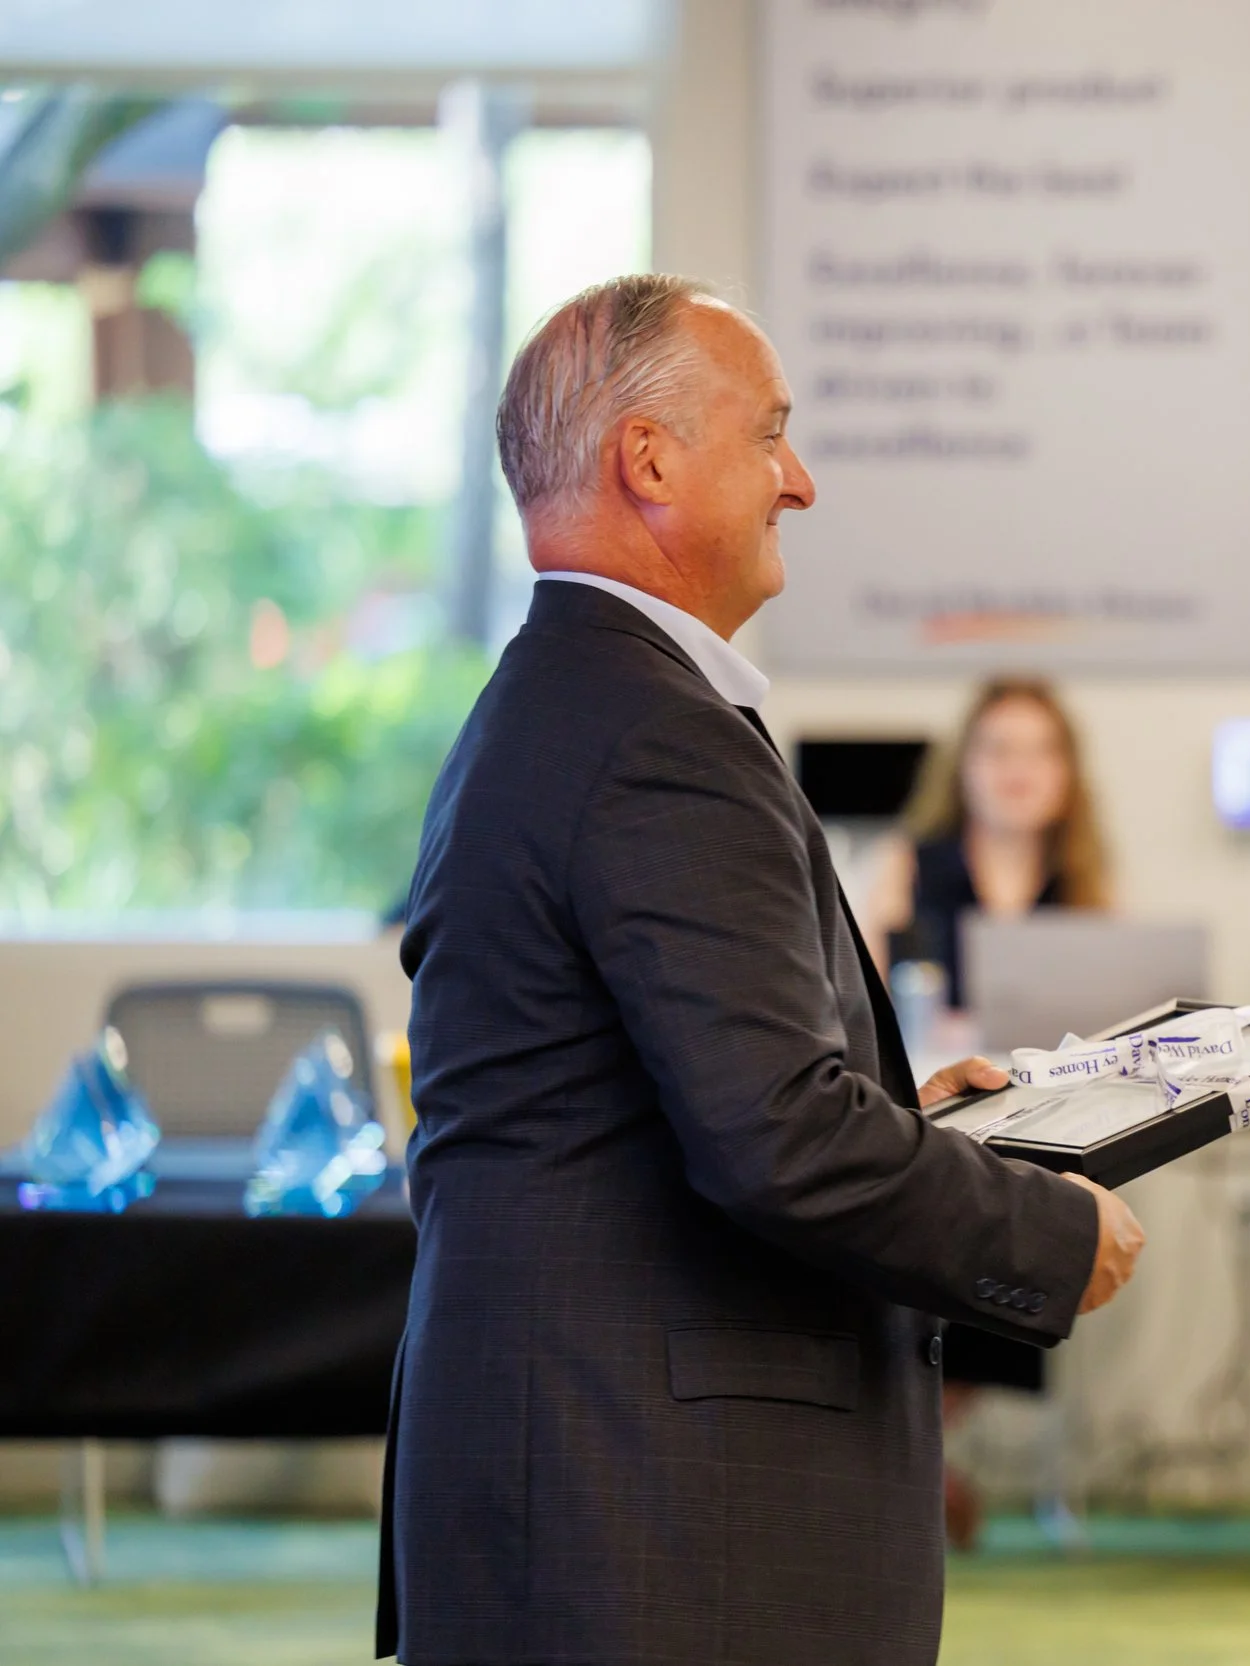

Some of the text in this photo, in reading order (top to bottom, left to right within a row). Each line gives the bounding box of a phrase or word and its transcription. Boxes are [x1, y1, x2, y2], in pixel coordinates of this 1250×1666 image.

[1129, 1034, 1144, 1068] Dav
[1188, 1040, 1233, 1059] David
[1008, 1068, 1032, 1084] Da
[1049, 1059, 1099, 1077] Homes
